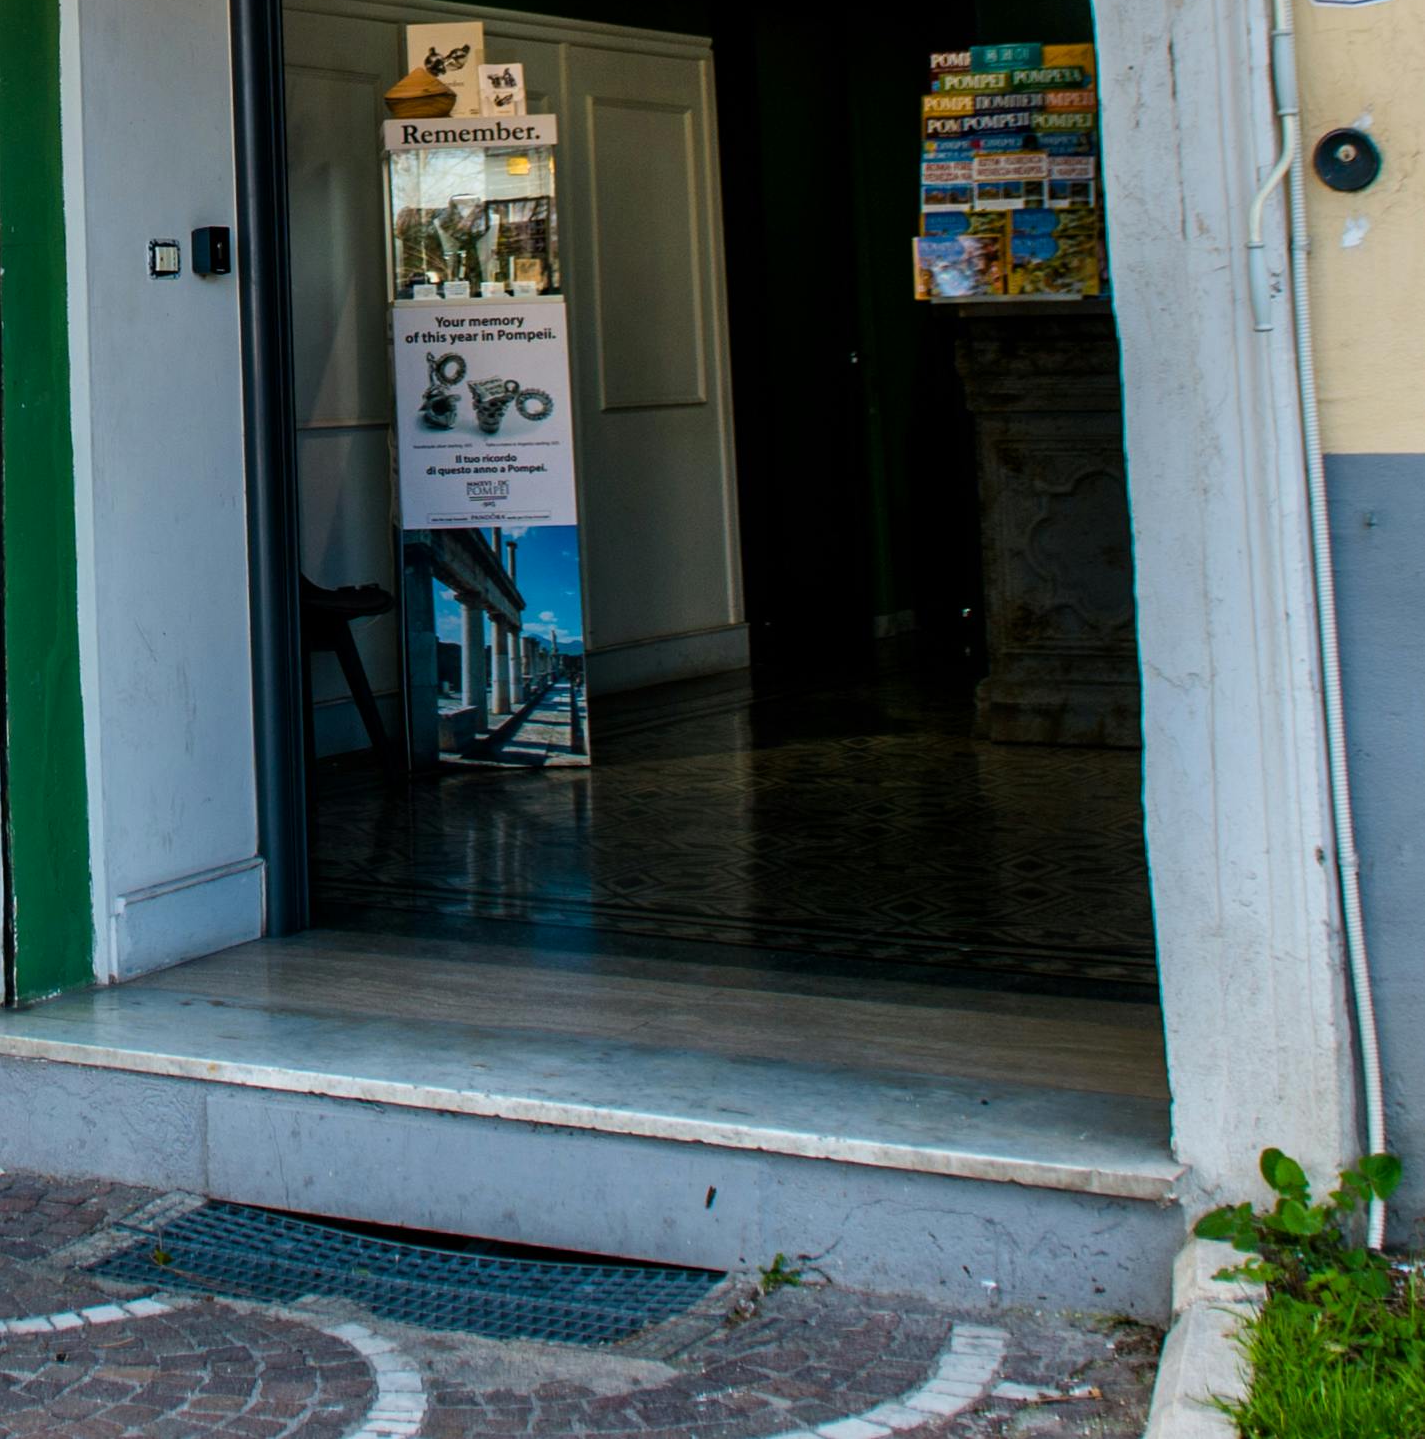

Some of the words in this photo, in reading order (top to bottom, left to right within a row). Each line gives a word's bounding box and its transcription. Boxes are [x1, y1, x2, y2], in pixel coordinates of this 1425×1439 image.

[401, 121, 541, 145] Remember.
[435, 317, 466, 328] Your
[469, 316, 524, 328] memory
[405, 331, 420, 344] of
[422, 331, 447, 343] this
[450, 333, 478, 345] year
[481, 330, 494, 341] in
[497, 328, 557, 343] Pompeii.
[464, 455, 480, 464] tuo
[482, 453, 517, 463] ricordo
[426, 465, 437, 476] di
[438, 465, 472, 477] questo
[473, 465, 499, 474] anno
[500, 465, 507, 473] a
[507, 463, 547, 475] Pompei.
[466, 484, 510, 496] POMPEI
